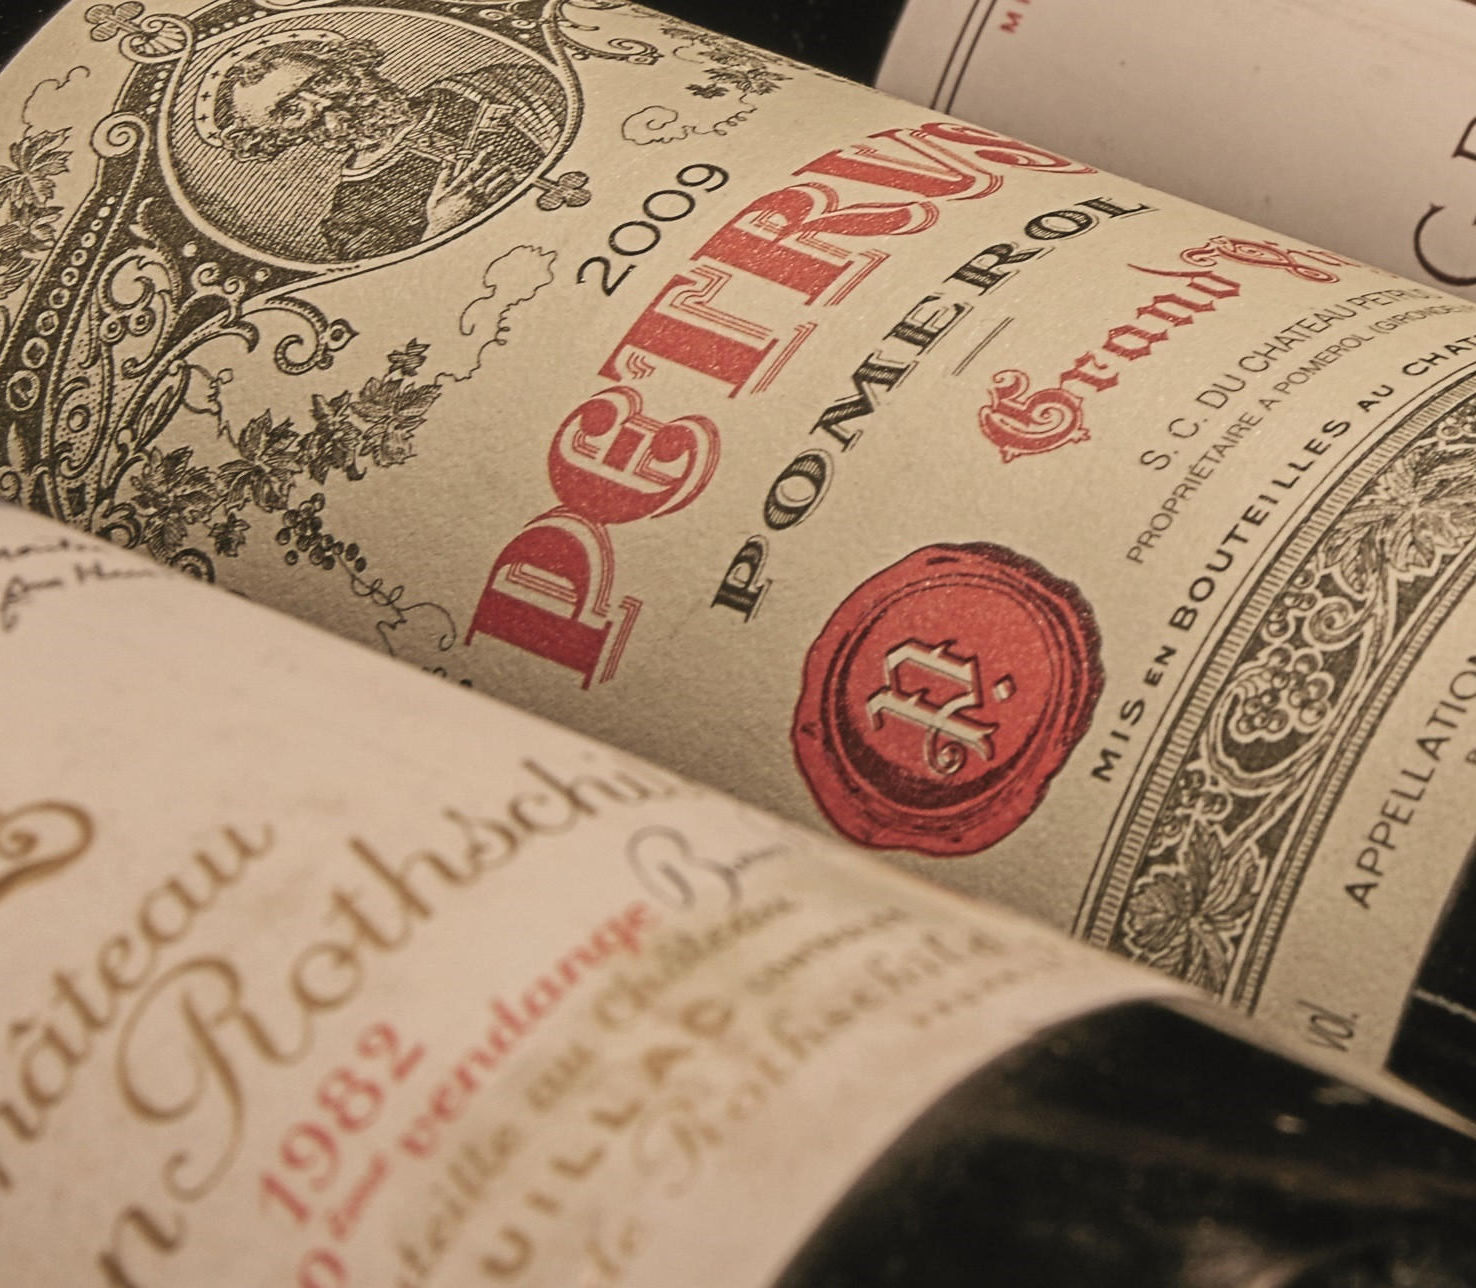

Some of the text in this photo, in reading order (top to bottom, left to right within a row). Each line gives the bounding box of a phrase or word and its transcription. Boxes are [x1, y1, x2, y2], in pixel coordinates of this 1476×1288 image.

[576, 161, 730, 296] 2009
[711, 195, 1158, 625] POMEROL
[977, 262, 1241, 465] Grand
[1126, 408, 1265, 566] PROPRIÉTAIRE
[1273, 332, 1376, 397] POMEROL
[1139, 440, 1180, 473] S.
[1166, 410, 1209, 442] C.
[1195, 371, 1247, 411] DU
[1237, 303, 1359, 374] CHATEAU
[1090, 698, 1146, 784] MIS
[1145, 644, 1178, 688] EN
[1170, 417, 1351, 632] BOUTEILLES
[1355, 384, 1395, 413] AU
[258, 1021, 426, 1228] 1982
[396, 901, 654, 1160] vendange
[478, 998, 738, 1284] UILLAC
